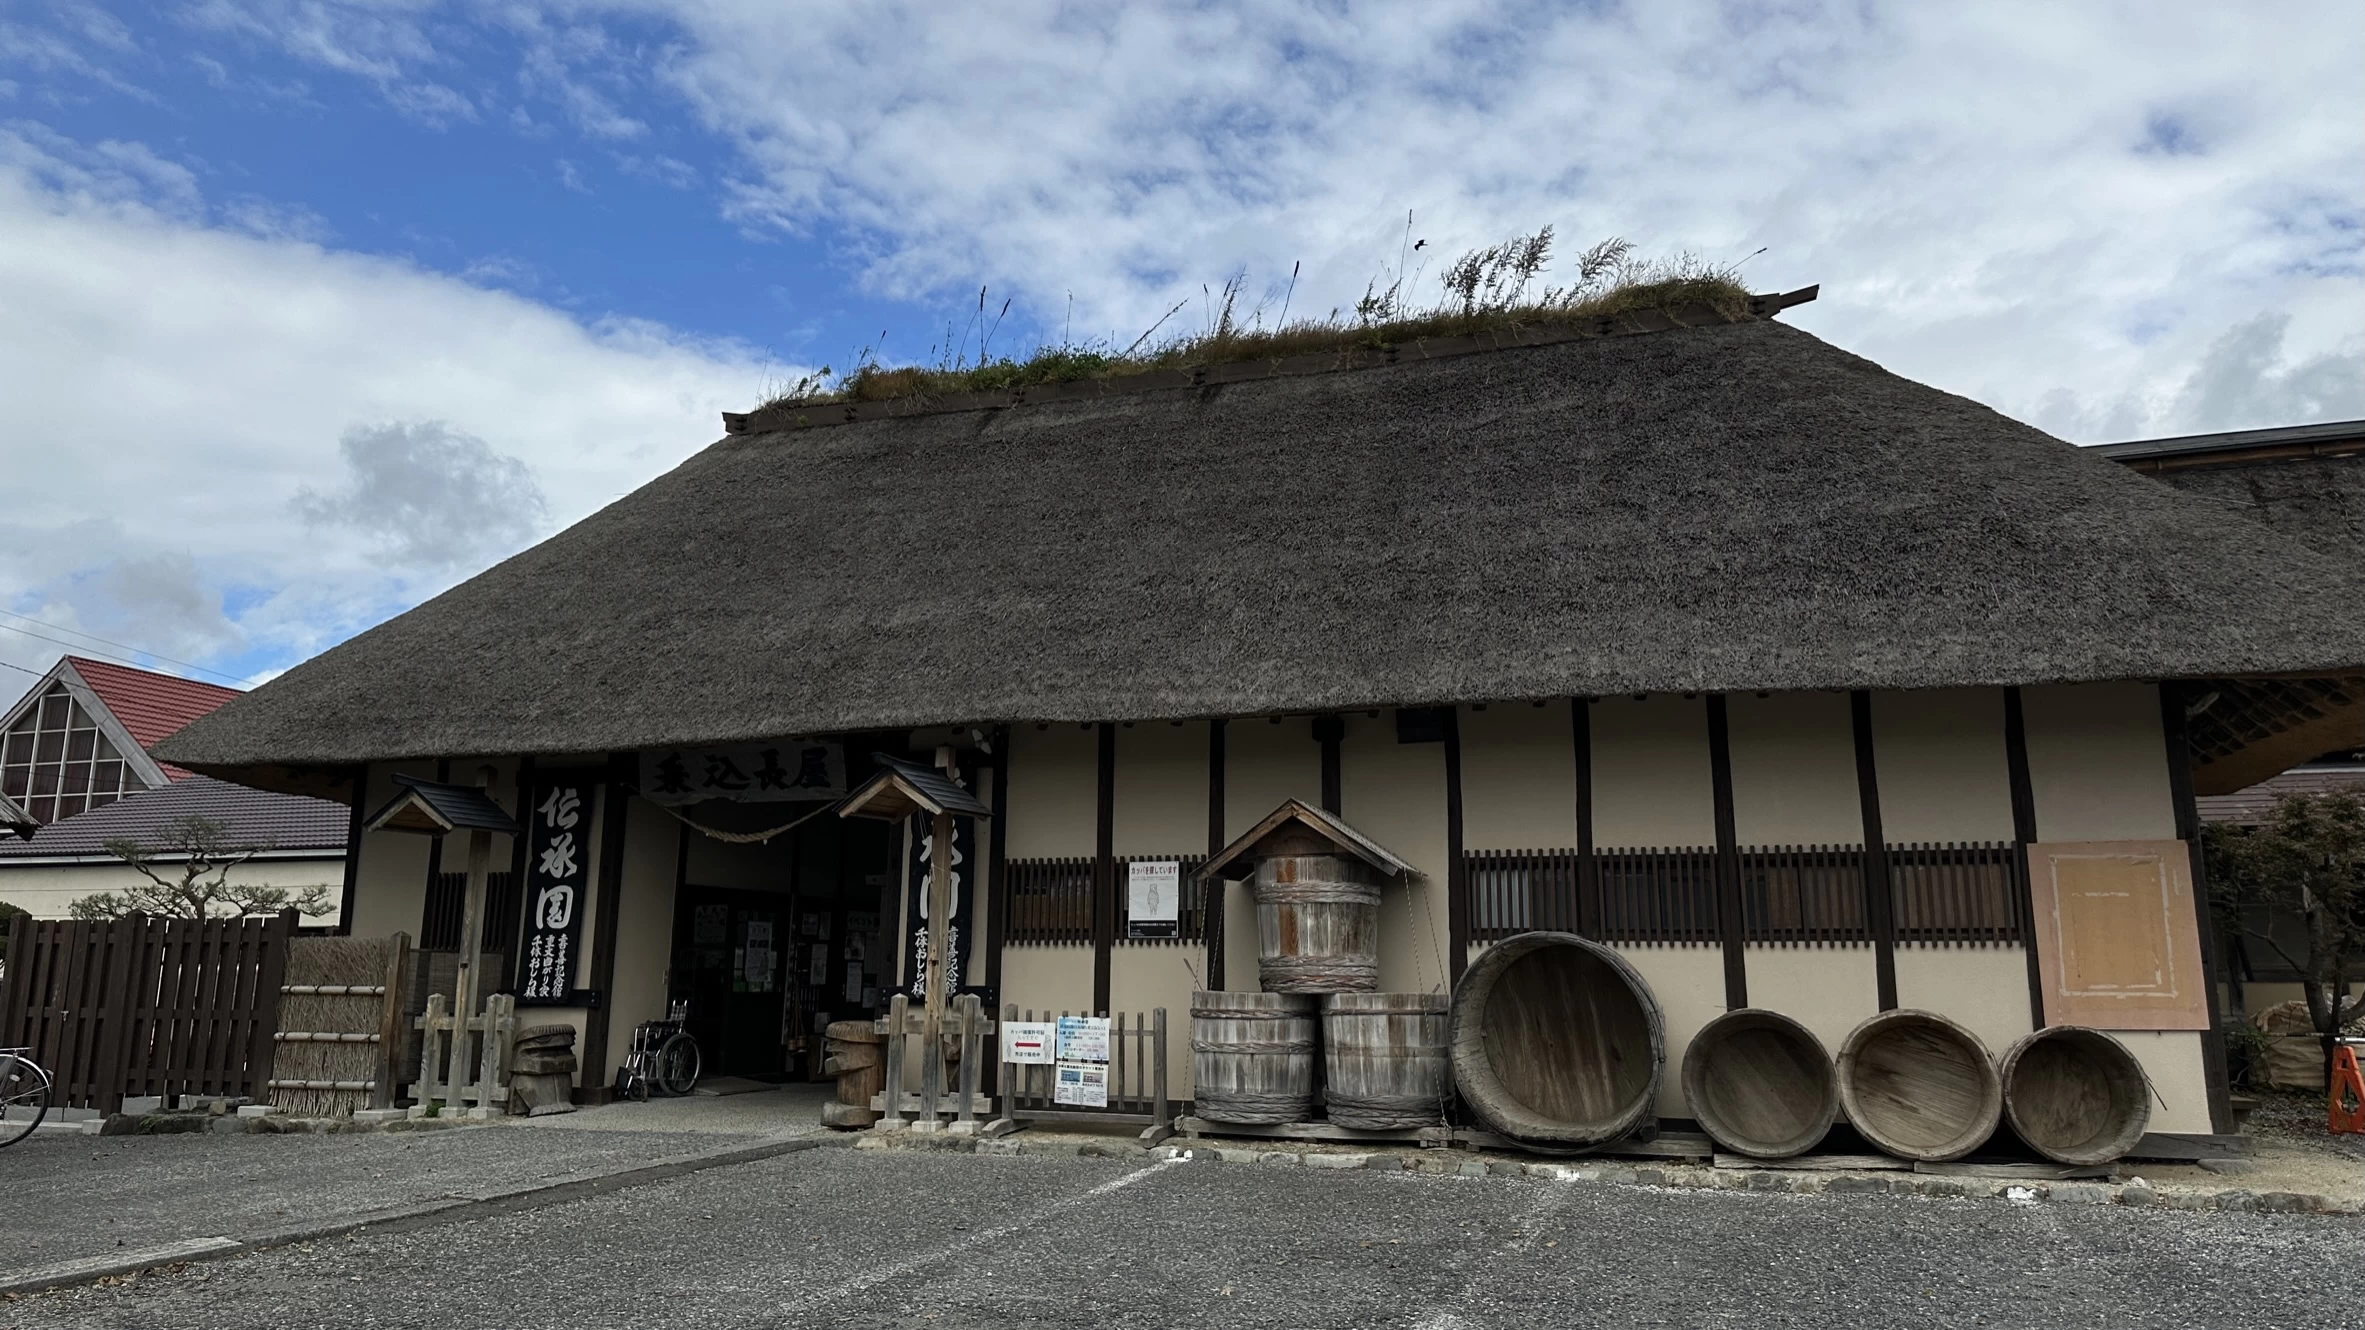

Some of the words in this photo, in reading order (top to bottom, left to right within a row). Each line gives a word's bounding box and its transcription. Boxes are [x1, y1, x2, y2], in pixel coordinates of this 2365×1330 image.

[536, 786, 581, 930] 伝承園
[1131, 866, 1177, 875] カッパを探しています
